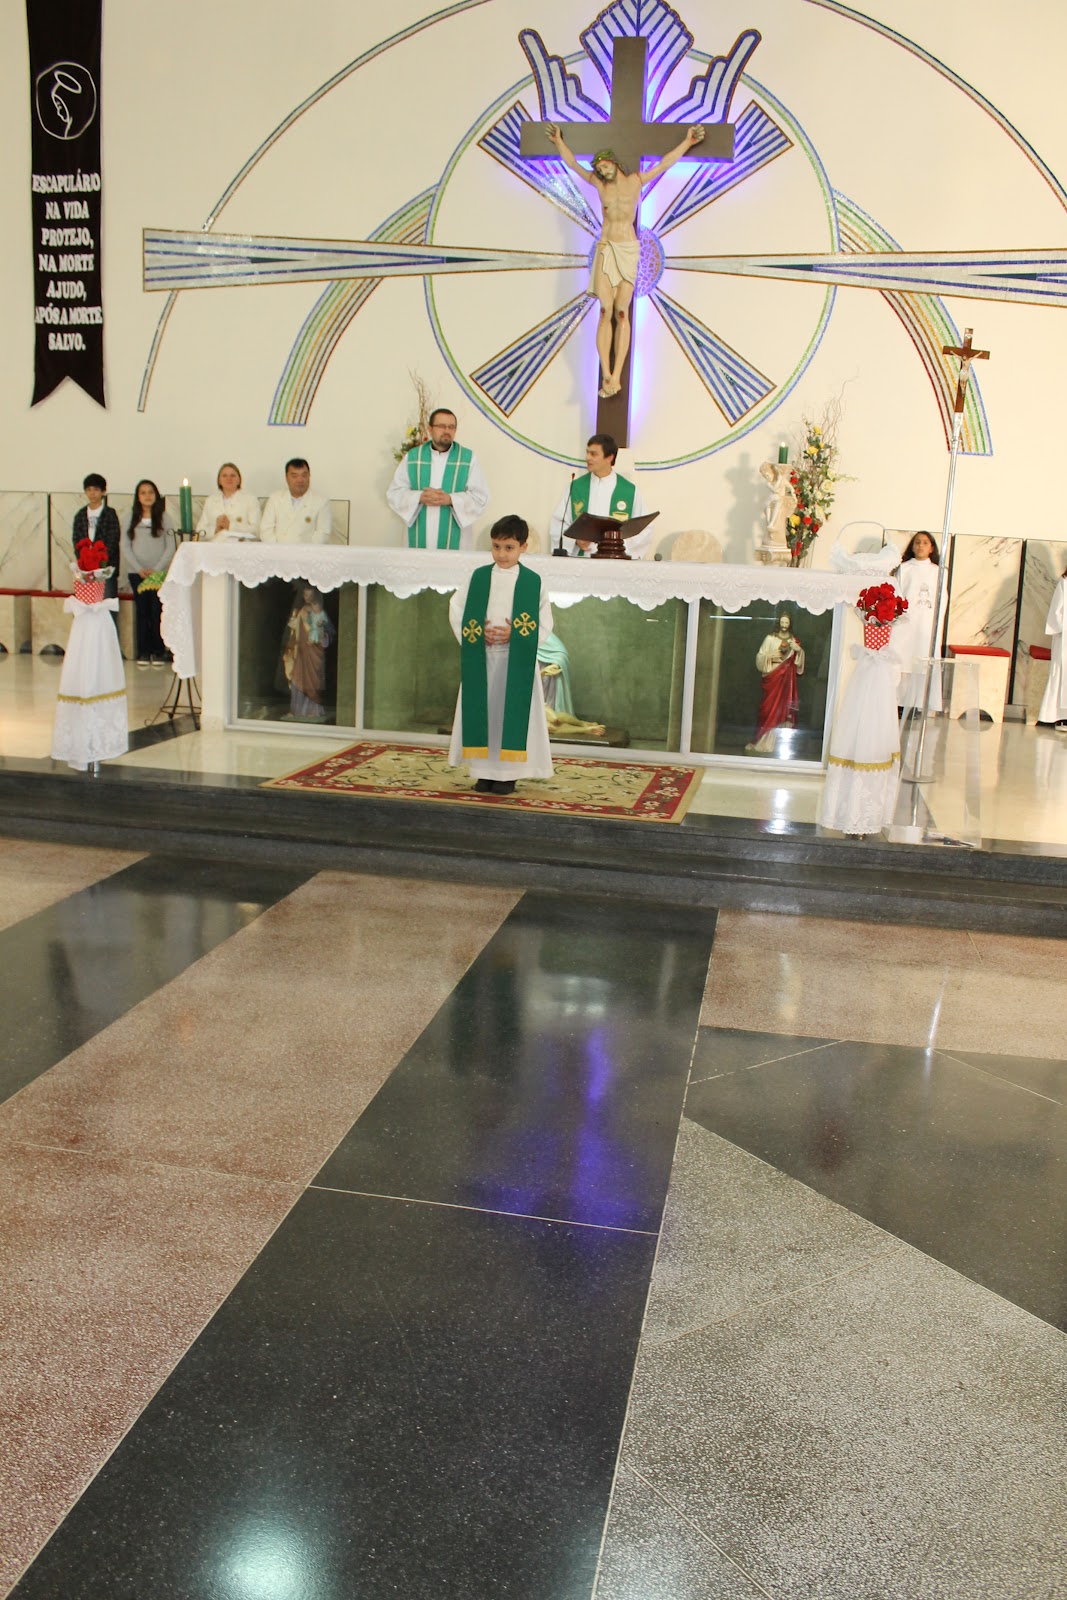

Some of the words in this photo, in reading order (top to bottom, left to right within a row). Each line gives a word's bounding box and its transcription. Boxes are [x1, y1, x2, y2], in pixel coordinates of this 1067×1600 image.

[32, 168, 101, 193] ESCAPULÁRIO
[45, 201, 61, 219] NA
[63, 201, 90, 219] VIDA
[41, 227, 94, 249] PROTEJO,
[38, 253, 58, 272] NA
[58, 254, 95, 272] MORTE
[46, 280, 87, 301] AJUDO,
[34, 302, 60, 325] APÓS
[59, 307, 68, 325] A
[68, 306, 103, 324] MORTE
[48, 332, 86, 350] SALVO.
